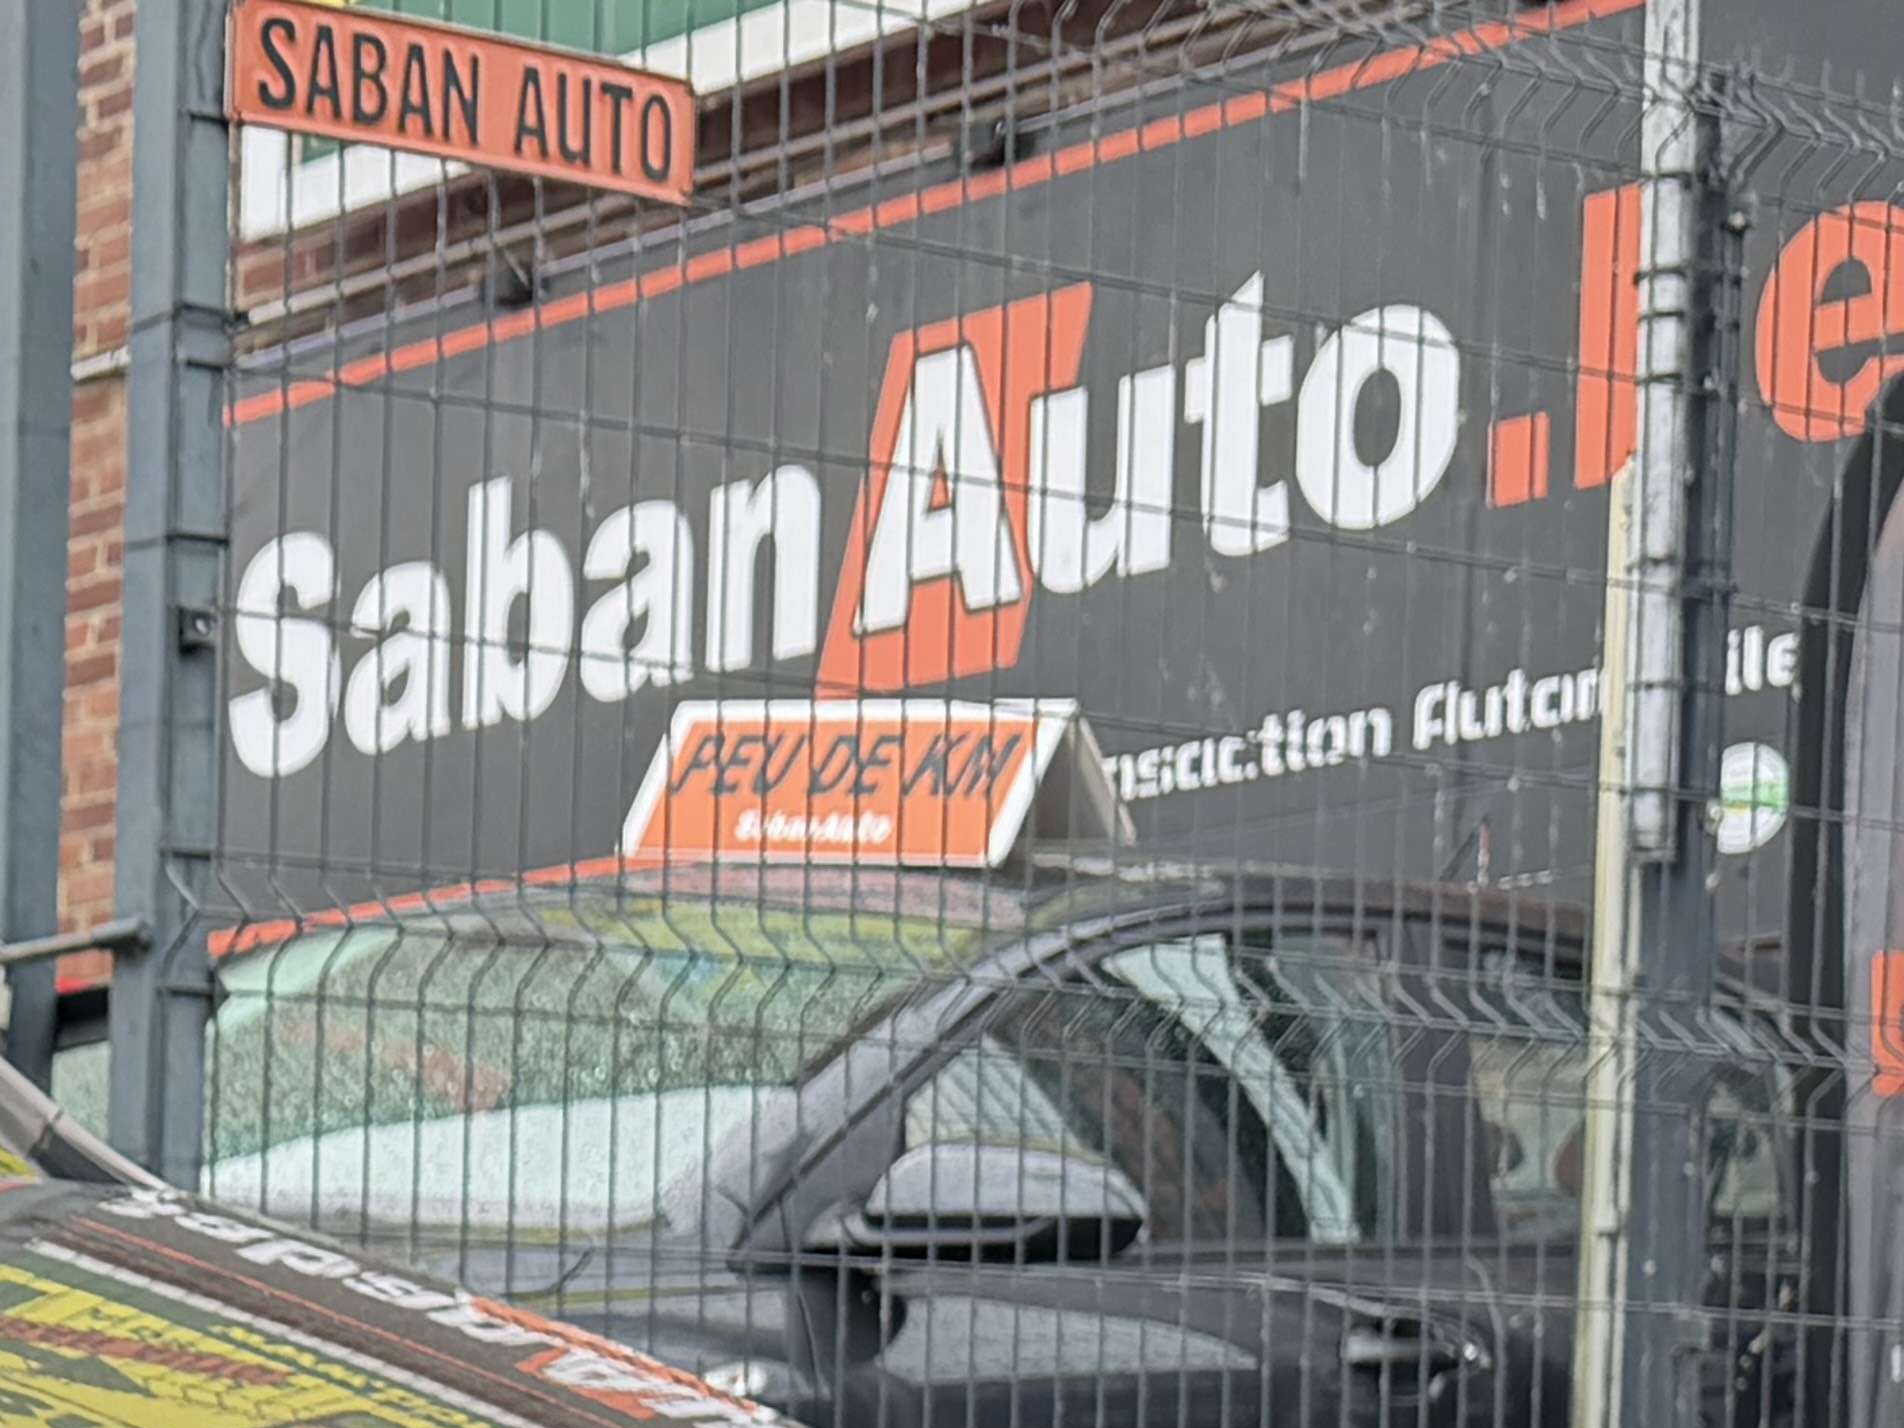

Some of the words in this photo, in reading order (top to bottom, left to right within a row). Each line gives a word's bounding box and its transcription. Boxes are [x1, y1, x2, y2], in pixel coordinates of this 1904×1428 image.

[257, 17, 480, 148] SABAN
[513, 65, 673, 182] AUTO
[672, 732, 805, 797] PEU
[810, 732, 903, 797] DE
